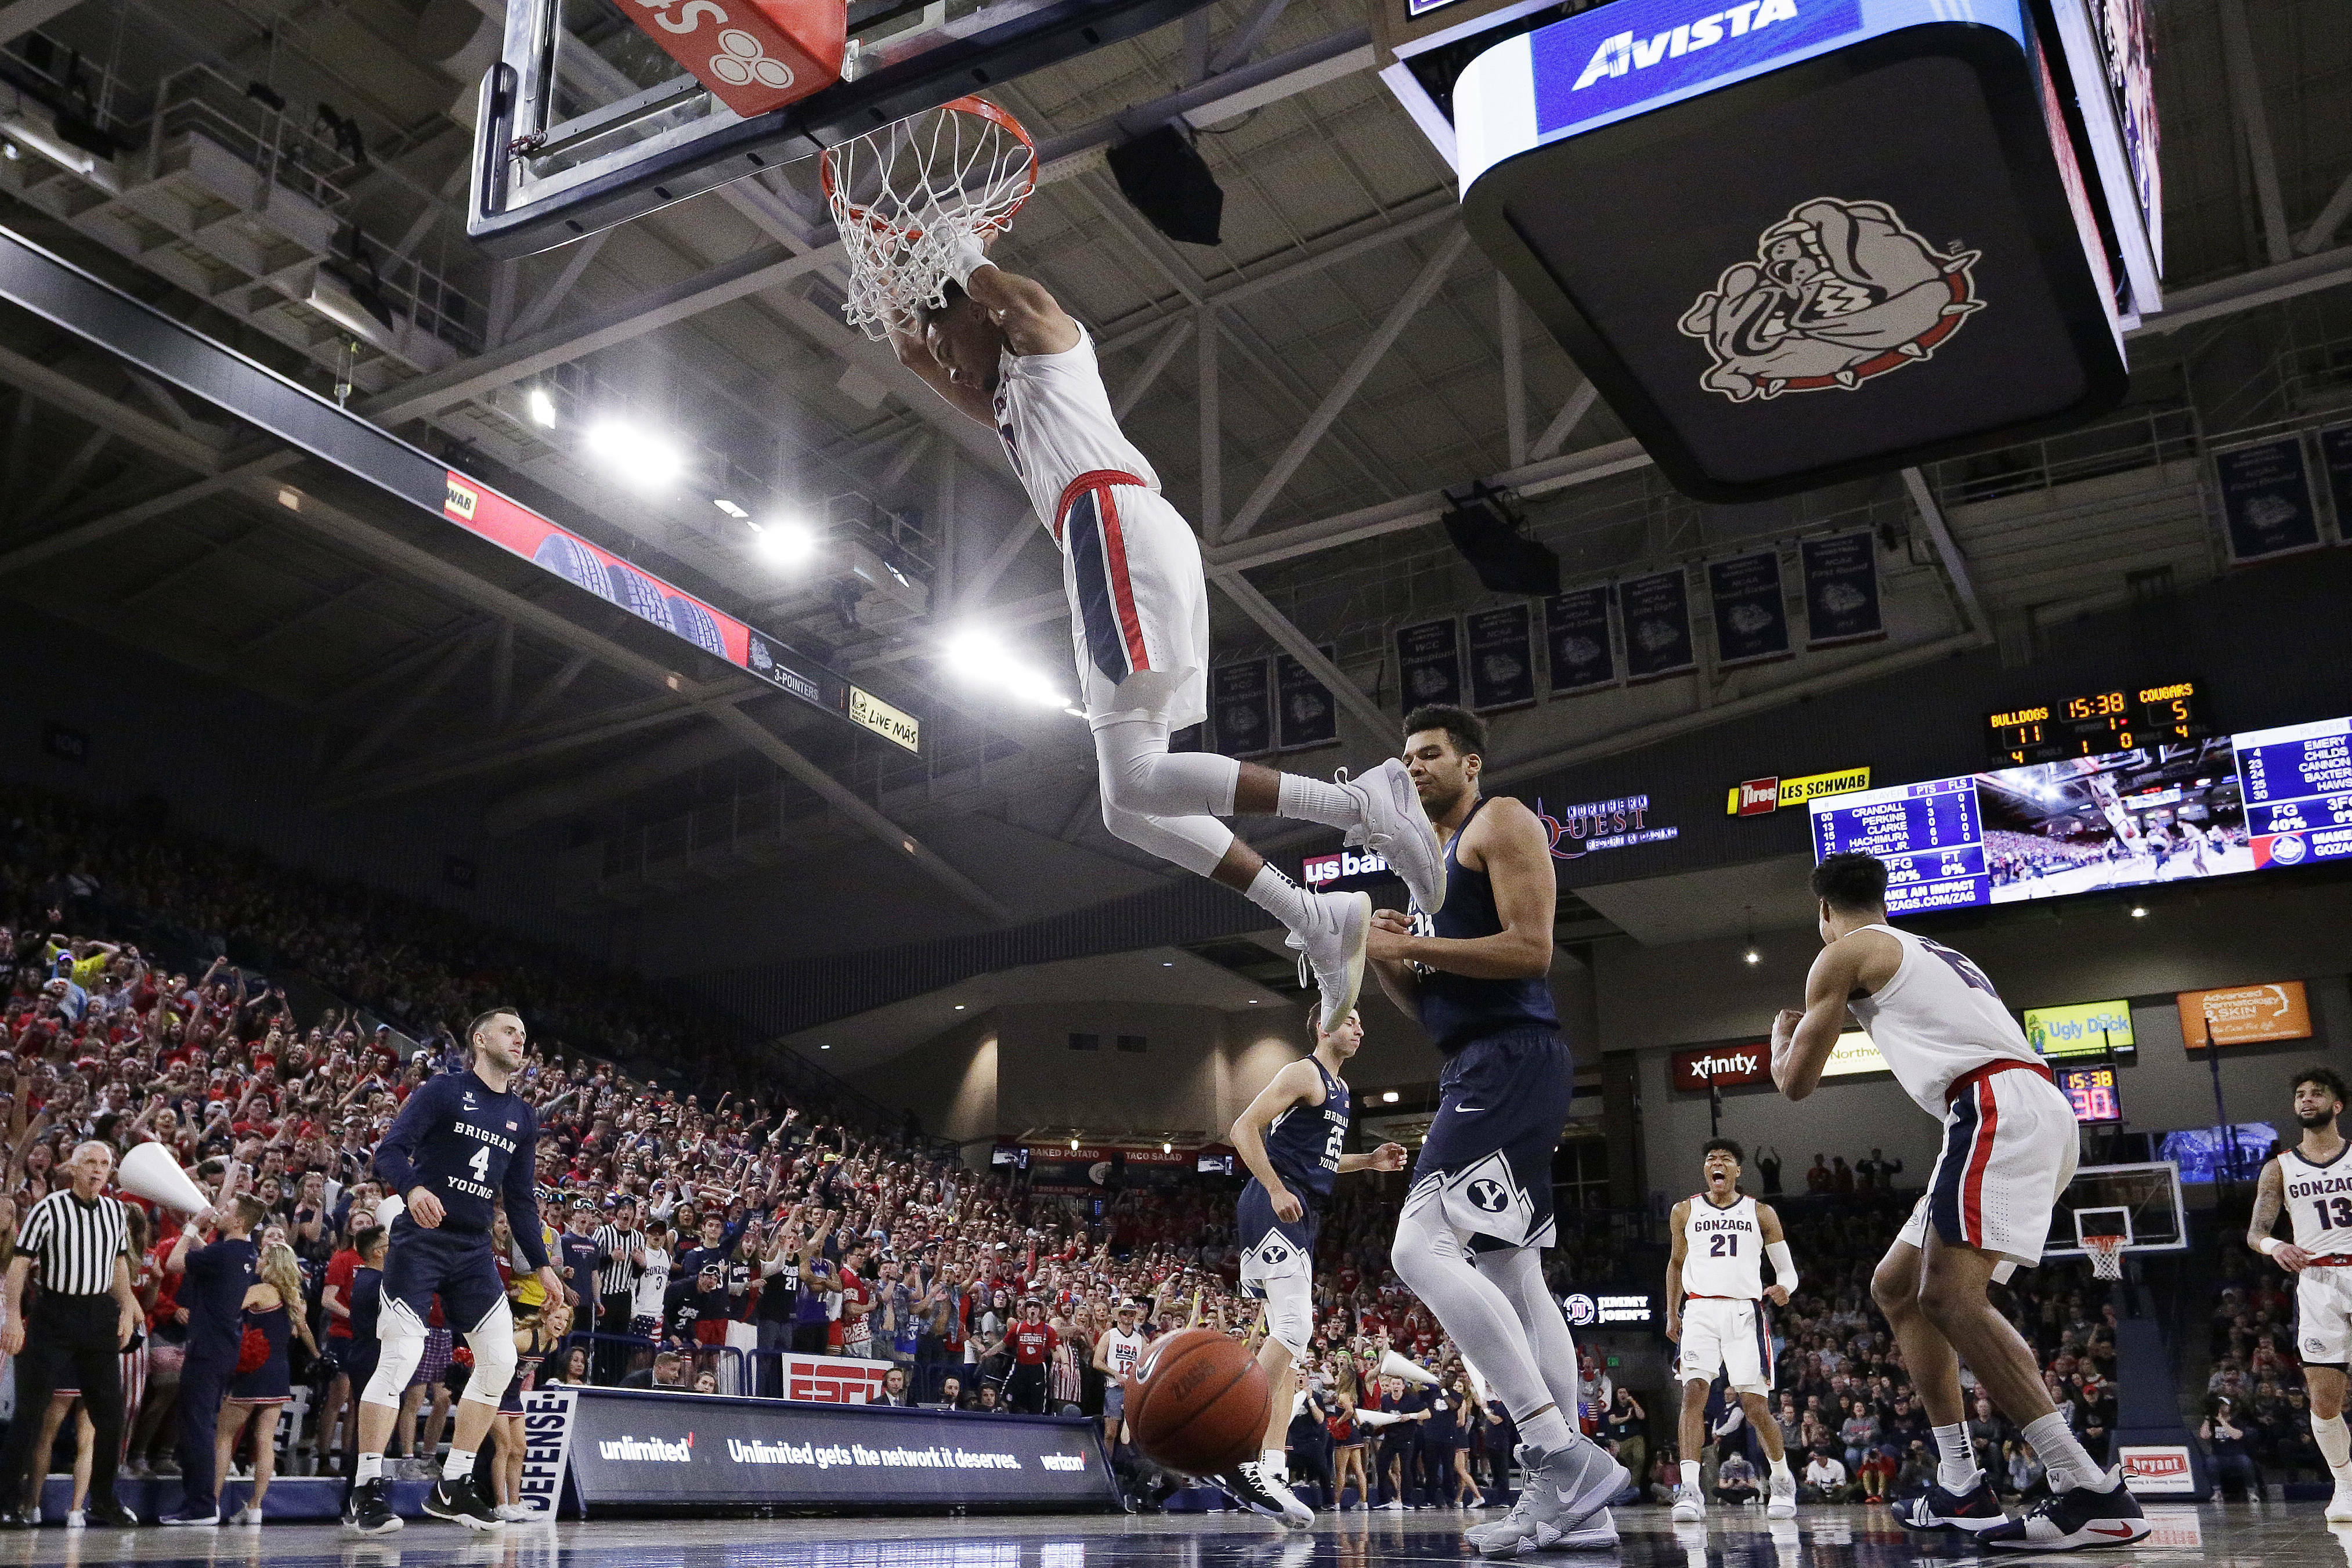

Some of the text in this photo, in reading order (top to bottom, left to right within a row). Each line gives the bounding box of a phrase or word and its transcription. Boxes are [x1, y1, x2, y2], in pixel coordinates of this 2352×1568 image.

[1572, 0, 1798, 91] AVISTA
[774, 669, 818, 700] 3-POINTERS
[2140, 682, 2194, 703] COUGARS
[2070, 692, 2125, 717] 15:38
[2172, 700, 2187, 720] 5
[1990, 707, 2048, 728] BULLDOGS
[2020, 725, 2040, 743] 11
[2176, 725, 2188, 738] 4
[2299, 722, 2343, 736] PLAYER
[2120, 732, 2133, 749] 0
[2253, 735, 2347, 757] 4 EMERY
[2012, 751, 2024, 764] 4
[2248, 746, 2349, 769] 23 CHILDS
[2250, 757, 2350, 779] 24 CANNON
[1781, 774, 1865, 799] LES SCHWAB
[2252, 767, 2352, 790] 25 BAXTER
[2253, 778, 2352, 800] 30 HAWS
[1742, 785, 1776, 808] Tires
[1866, 779, 1967, 801] PLAYER PTS FLS
[1567, 794, 1649, 818] NORTHERN
[1821, 793, 1964, 822] 00 CRANDALL 0 0
[2272, 804, 2298, 818] FG
[1822, 803, 1966, 831] 13 PERKINS 3 1
[1823, 812, 1967, 840] 15 CLARKE 0 0
[2268, 816, 2307, 832] 40%
[1587, 836, 1625, 851] RESORT
[1824, 822, 1969, 851] 21 HACHIMURA 6 0
[1895, 841, 1910, 851] JR.
[1931, 836, 1938, 846] 0
[1963, 832, 1970, 841] 0
[2311, 829, 2352, 845] MAKE
[1941, 850, 1960, 864] FT
[2314, 842, 2352, 856] GOZA
[1888, 862, 1966, 884] 50% 0%
[1884, 879, 1975, 901] AKE AN IMPACT
[1887, 891, 1975, 912] ZAGS.COM/ZAG
[2203, 989, 2263, 1002] Advanced
[2203, 996, 2280, 1010] Dermatology
[2218, 1006, 2257, 1017] SKIN
[2048, 1014, 2129, 1040] Ugly Duck
[1830, 1047, 1880, 1060] Northw
[2069, 1071, 2113, 1089] 15:38
[2072, 1089, 2111, 1119] 30
[1029, 1148, 1099, 1158] BAKED POTATO
[1126, 1151, 1182, 1161] TACO SALAD
[469, 1146, 490, 1182] 4
[447, 1176, 493, 1200] YOUNG
[1474, 1180, 1505, 1211] Y
[2313, 1197, 2352, 1230] 13
[1695, 1219, 1752, 1233] GONZAGA
[1264, 1247, 1285, 1263] Y
[1710, 1234, 1737, 1257] 21
[656, 1277, 662, 1289] 3
[785, 1277, 797, 1290] 21
[1597, 1296, 1648, 1310] JIMMY
[1598, 1309, 1651, 1324] JOHN'S
[1117, 1343, 1137, 1357] USA
[599, 1435, 691, 1462] unlimited
[727, 1439, 1021, 1469] Unlimited gets the network it deserves.
[1041, 1451, 1085, 1471] verizon
[2133, 1458, 2179, 1473] bryant
